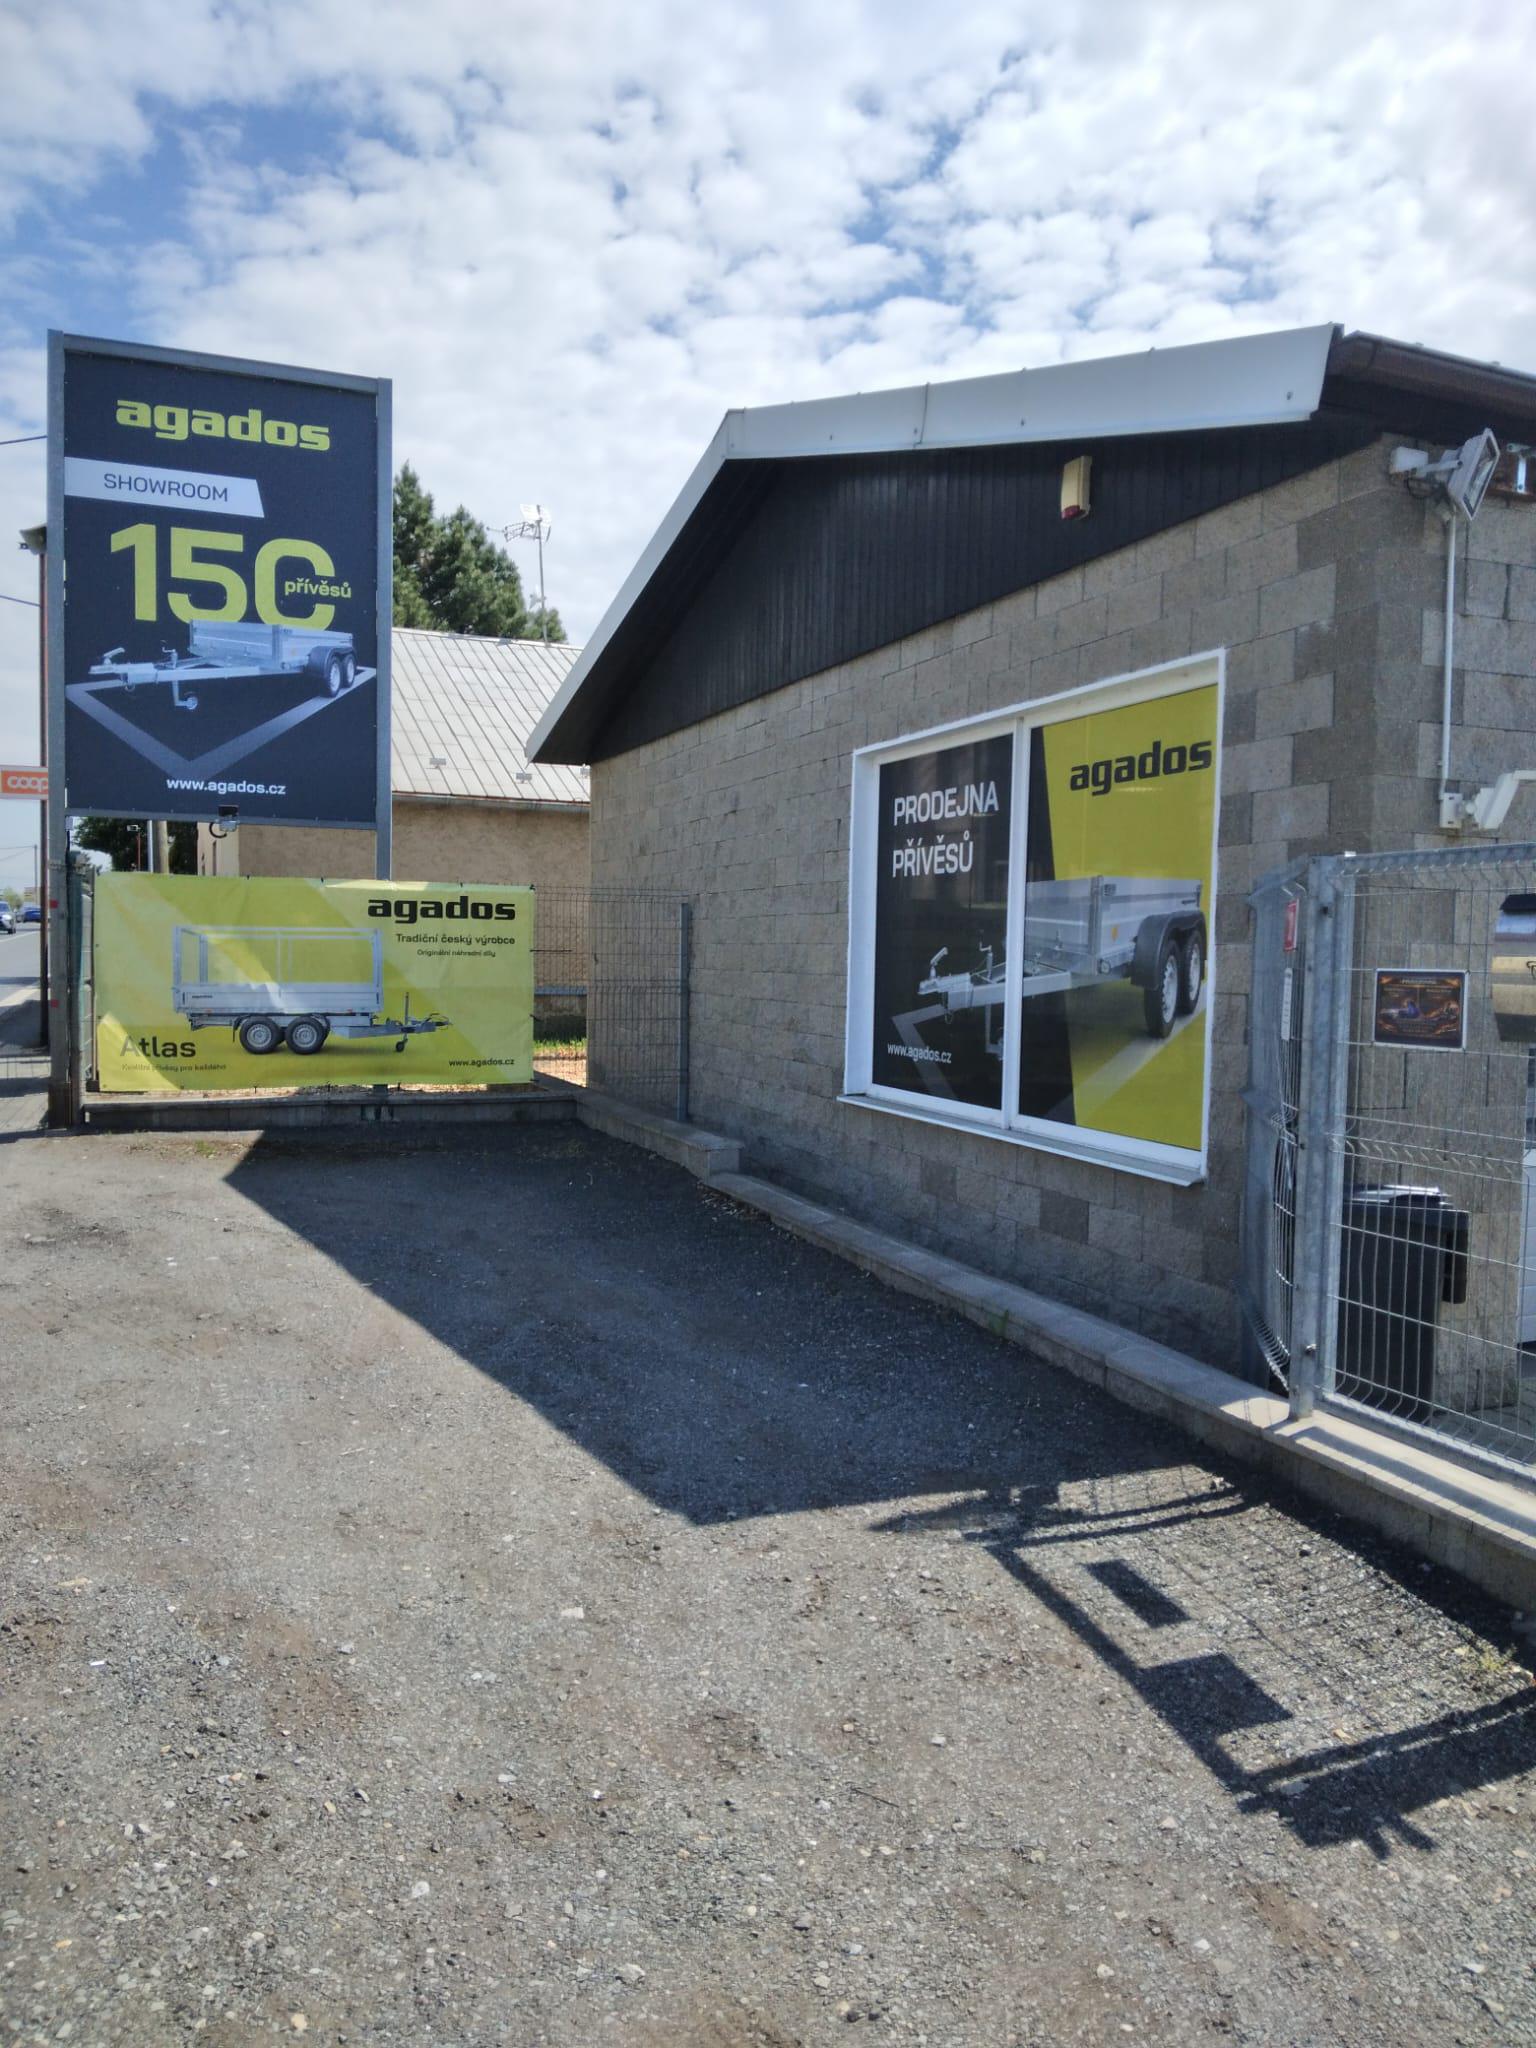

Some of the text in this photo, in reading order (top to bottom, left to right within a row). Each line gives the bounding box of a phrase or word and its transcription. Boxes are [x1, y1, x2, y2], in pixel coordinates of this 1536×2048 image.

[116, 400, 330, 451] agados
[104, 473, 228, 502] SHOWROOM
[285, 577, 352, 599] přívěsů
[1070, 740, 1212, 796] agados
[166, 779, 286, 795] www.agados.cz
[893, 780, 999, 826] PRODEJNA
[892, 830, 974, 878] PŘÍVĚSŮ
[368, 896, 516, 924] agados
[396, 933, 516, 945] Tradiční český výrobce
[120, 1036, 196, 1058] Atlas
[886, 1043, 952, 1064] www.agados.cz
[448, 1058, 515, 1068] www.agados.cz
